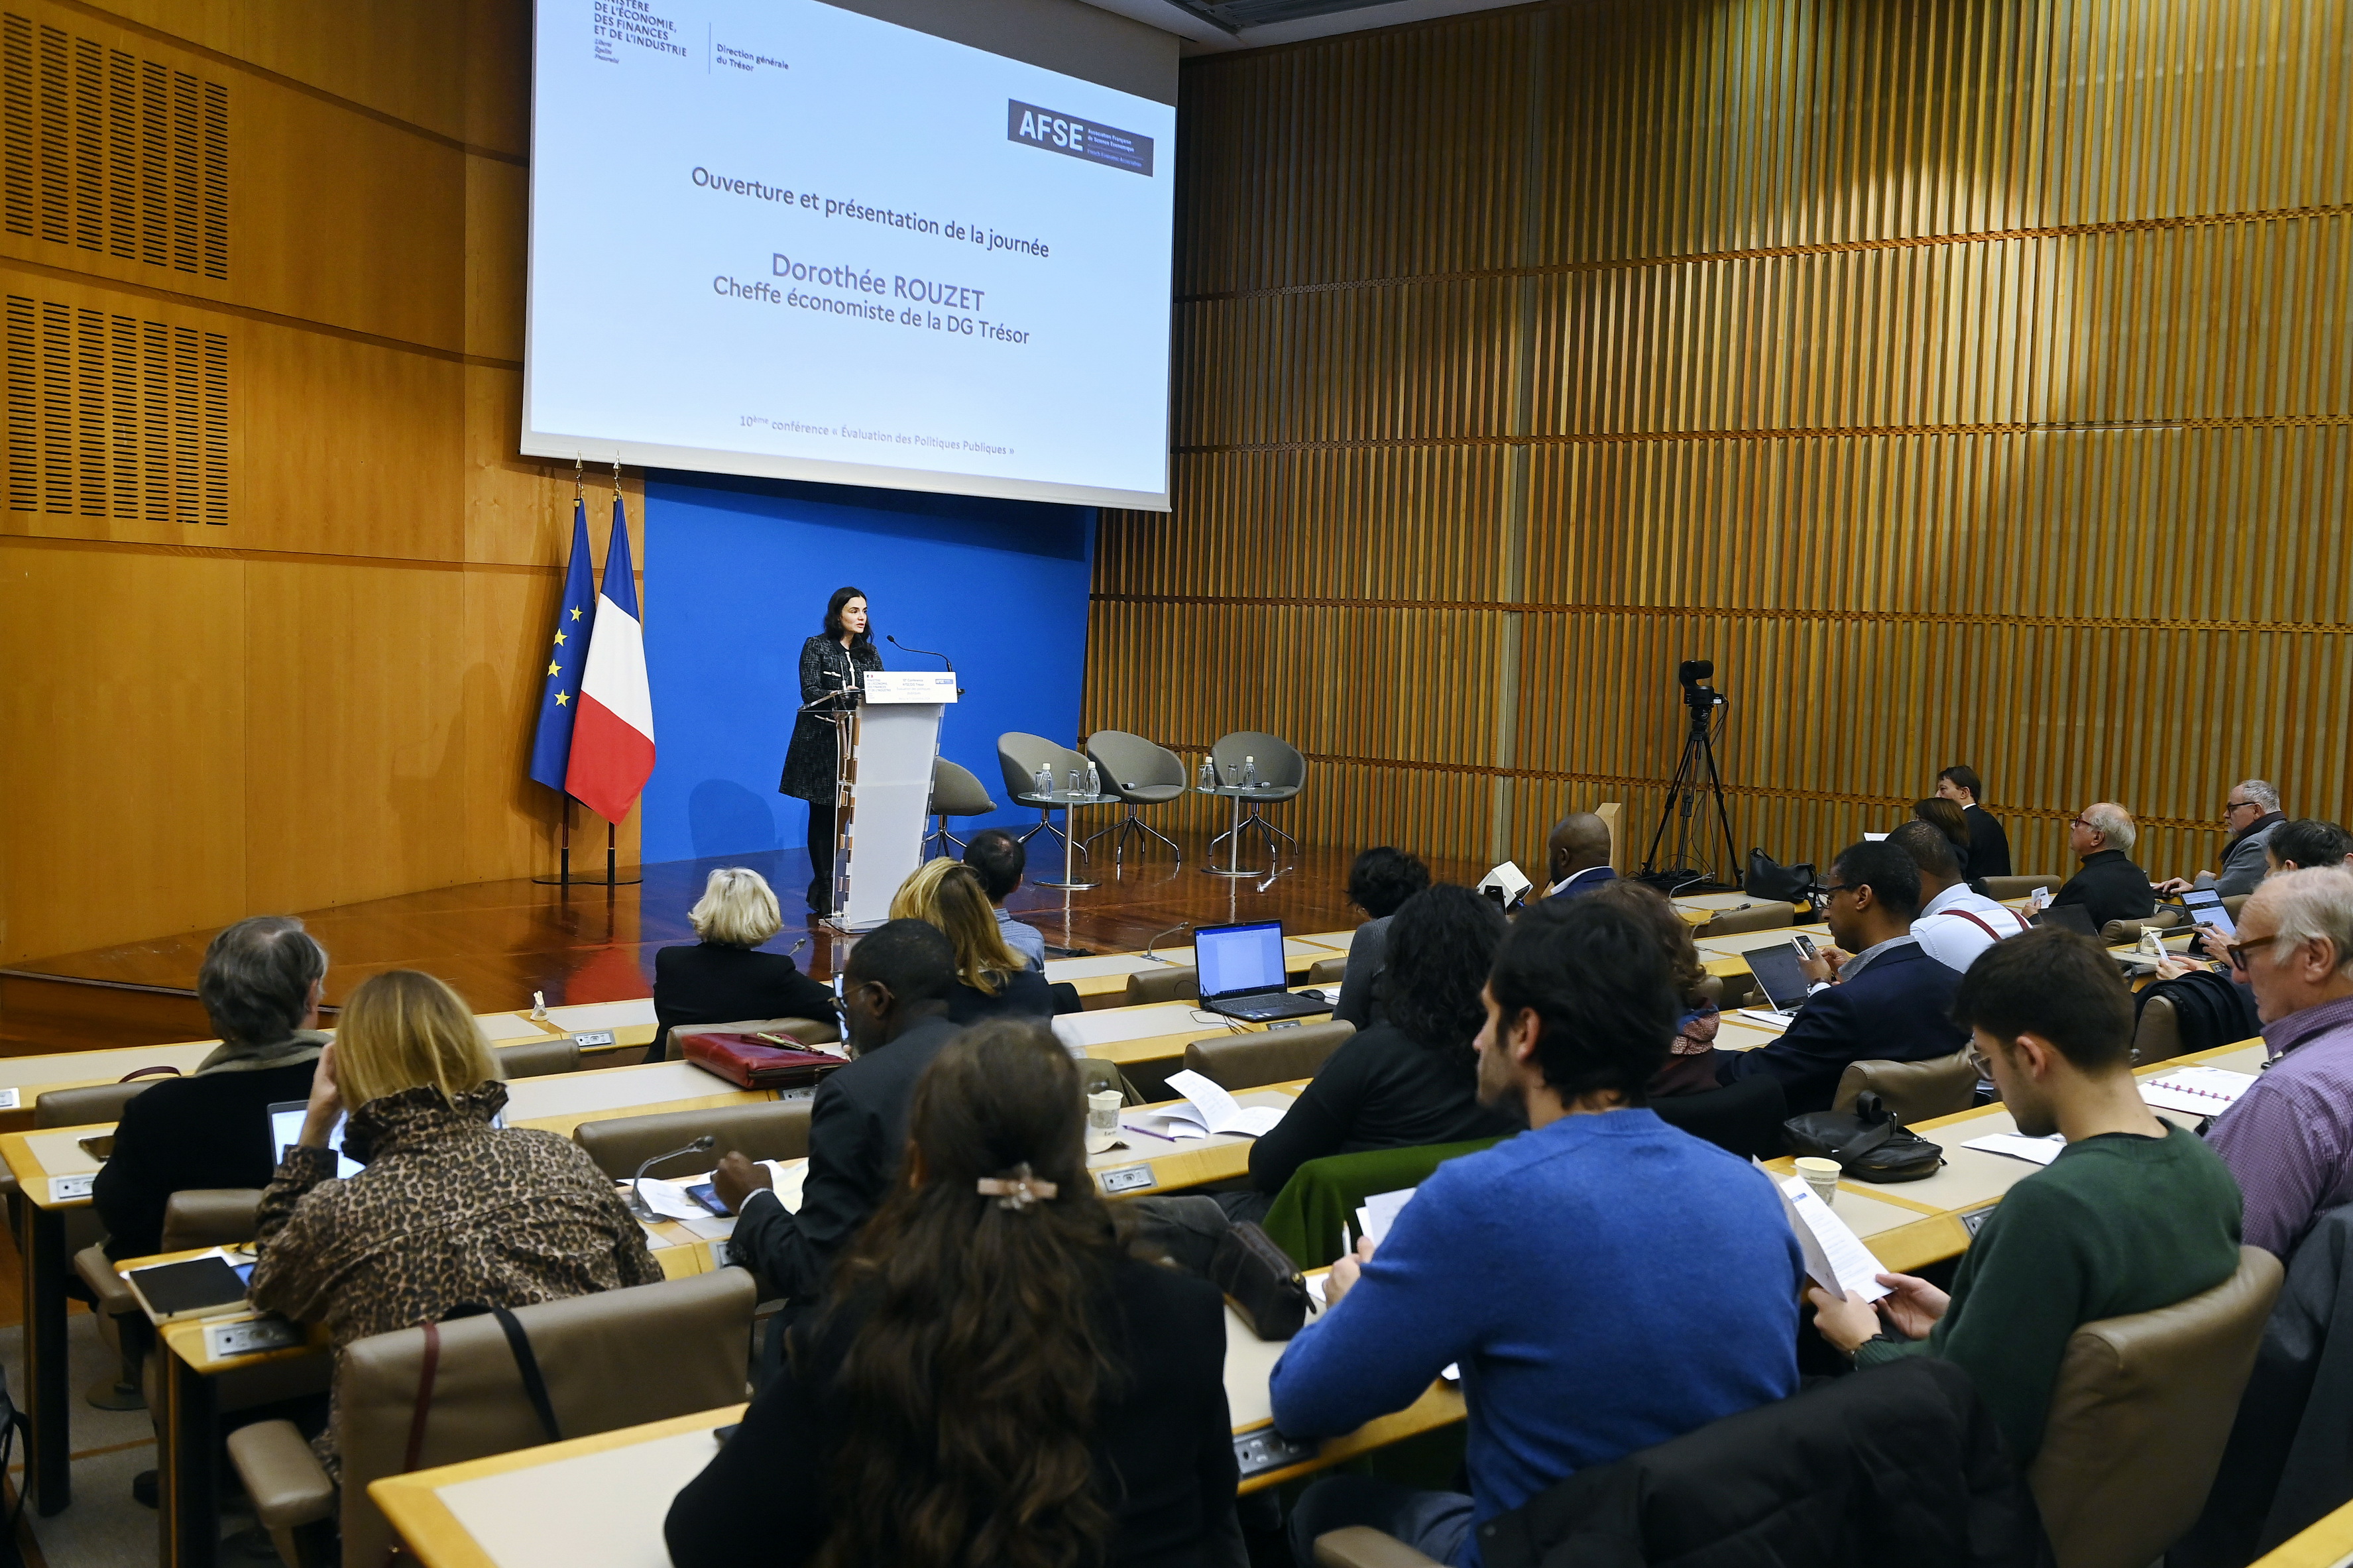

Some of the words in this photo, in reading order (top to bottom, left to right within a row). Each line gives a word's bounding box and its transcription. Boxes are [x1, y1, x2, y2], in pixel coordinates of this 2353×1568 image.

[595, 1, 608, 13] DE
[595, 13, 614, 27] DES
[617, 19, 669, 40] FINANCES
[595, 25, 606, 36] ET
[610, 28, 622, 40] DE
[626, 33, 687, 57] L'INDUSTRIE
[717, 43, 754, 61] Direction
[756, 54, 789, 70] générale
[717, 56, 728, 65] du
[729, 58, 754, 72] Trésor
[1019, 109, 1084, 152] AFSE
[692, 166, 795, 205] Ouverture
[800, 193, 820, 211] et
[826, 199, 940, 235] présentation
[945, 221, 966, 241] de
[970, 225, 984, 245] la
[988, 229, 1049, 258] journée
[772, 252, 886, 295] Dorothée
[895, 275, 985, 311] ROUZET
[713, 276, 781, 304] Cheffe
[787, 288, 895, 323] économiste
[900, 308, 923, 327] de
[928, 311, 941, 331] la
[948, 316, 974, 336] DG
[979, 320, 1030, 345] Trésor
[740, 416, 769, 427] 10ème
[772, 421, 829, 435] conférence
[842, 425, 893, 442] Évaluation
[895, 433, 911, 444] des
[915, 435, 960, 450] Politiques
[963, 440, 1007, 455] Publiques
